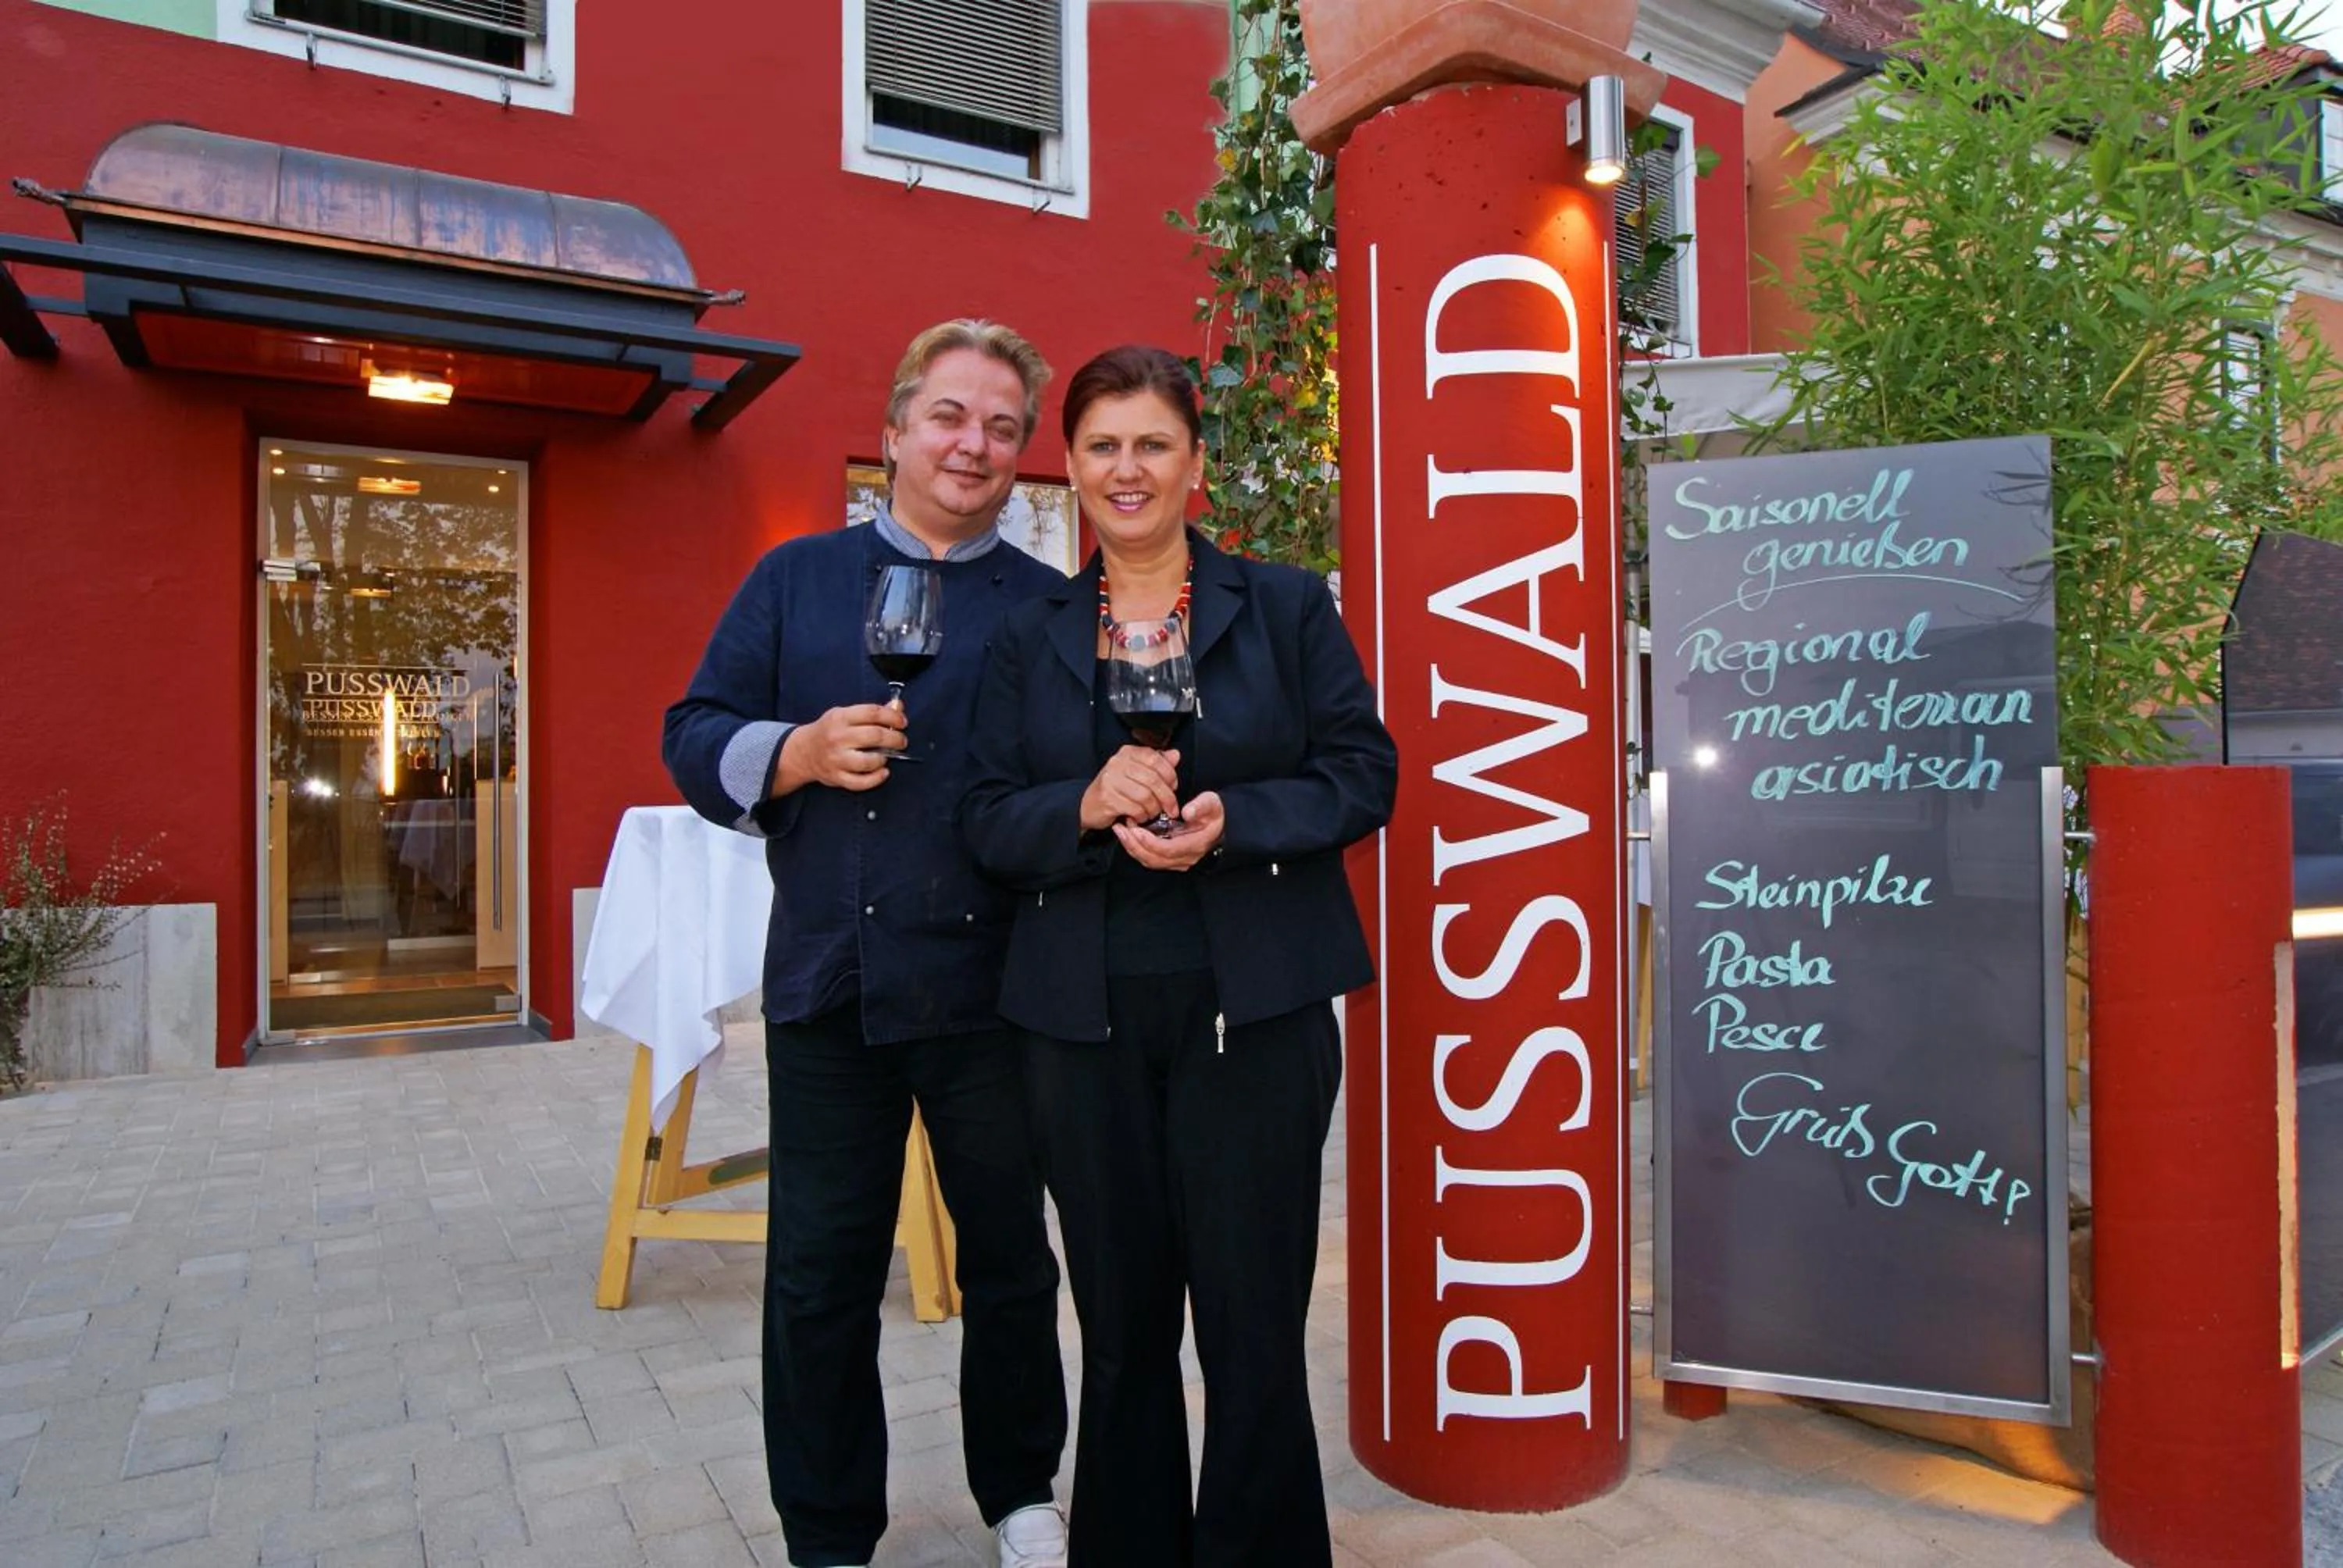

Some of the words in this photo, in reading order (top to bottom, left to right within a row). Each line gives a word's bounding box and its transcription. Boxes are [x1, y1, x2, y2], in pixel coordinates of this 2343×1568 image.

[1665, 469, 1914, 540] Saisonell
[1737, 521, 1969, 611] genießen
[305, 671, 471, 697] PUSSWALD
[1675, 611, 1931, 697] Regional
[1750, 734, 2003, 800] asiatisch
[1425, 253, 1592, 1432] PUSSWALD
[1697, 931, 1835, 989] Pasta
[1692, 992, 1828, 1053] Pesce
